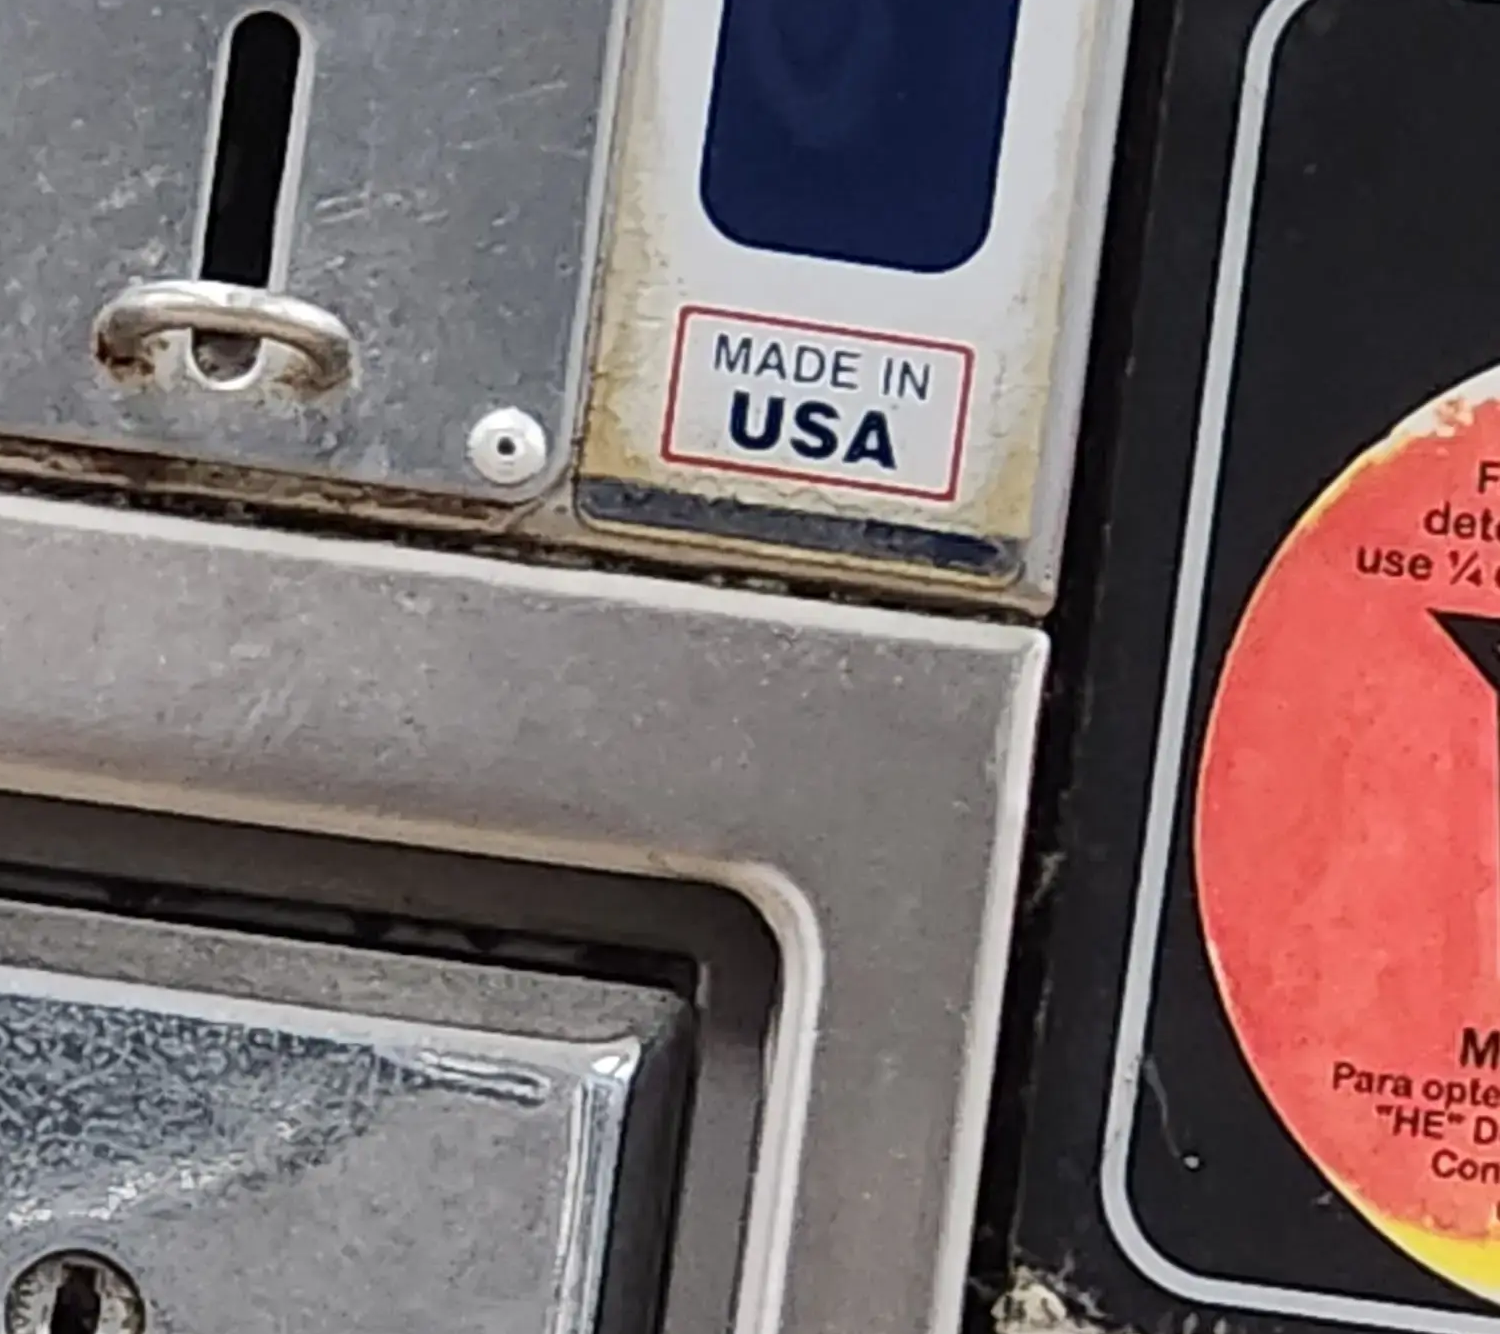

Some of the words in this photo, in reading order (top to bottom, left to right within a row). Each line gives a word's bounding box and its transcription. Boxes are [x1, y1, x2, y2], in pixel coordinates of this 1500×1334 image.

[713, 333, 862, 389] MADE
[882, 358, 931, 400] IN
[729, 390, 898, 470] USA
[1356, 546, 1434, 581] use
[1332, 1061, 1413, 1099] Para
[1376, 1104, 1466, 1140] "HE"
